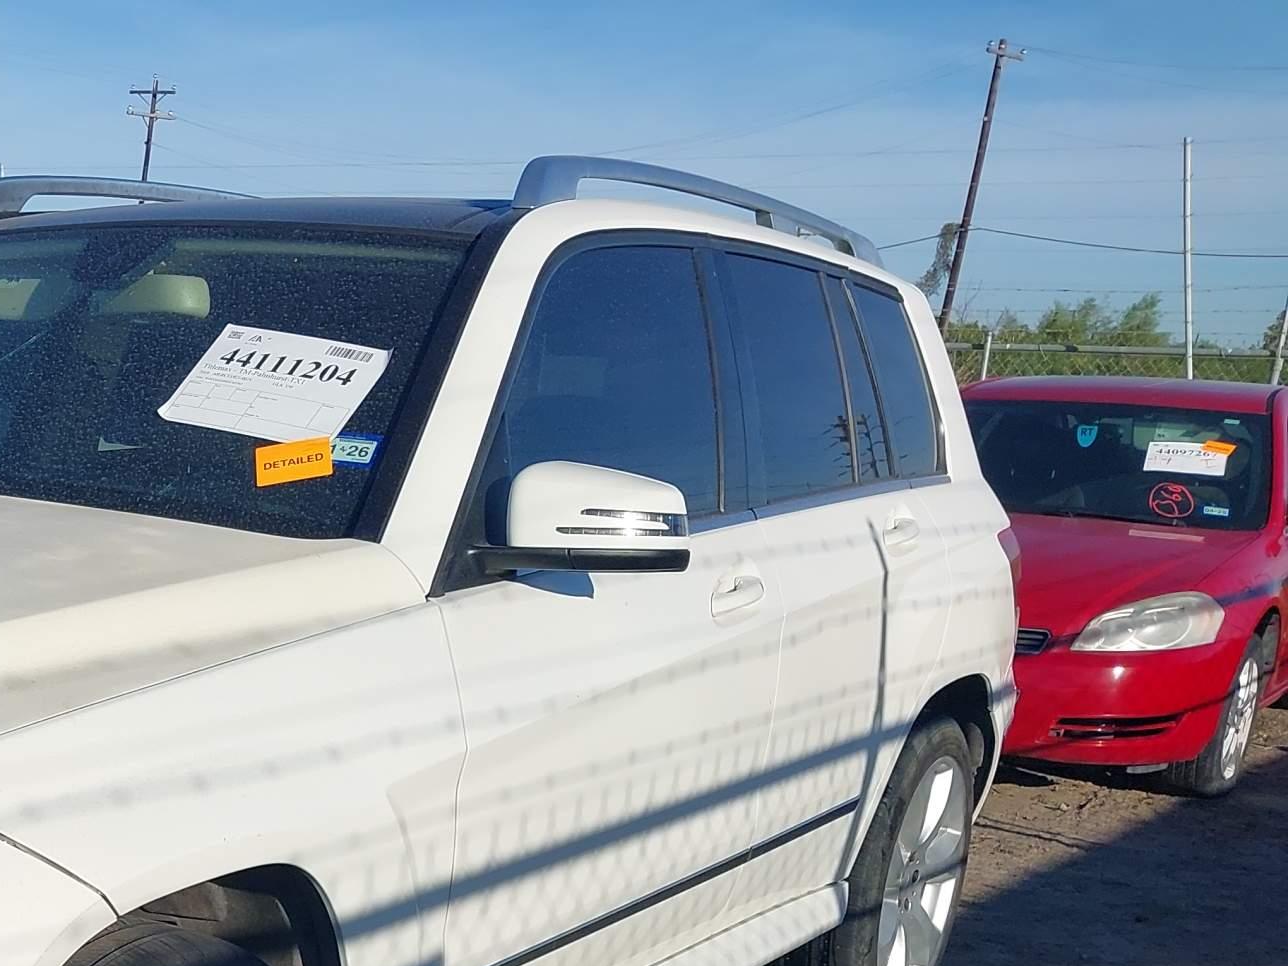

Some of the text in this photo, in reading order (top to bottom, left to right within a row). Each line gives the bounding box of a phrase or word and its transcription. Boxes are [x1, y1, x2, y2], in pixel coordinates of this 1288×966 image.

[220, 348, 358, 386] 44111204
[1080, 427, 1094, 437] RT
[263, 452, 324, 471] DETAILED
